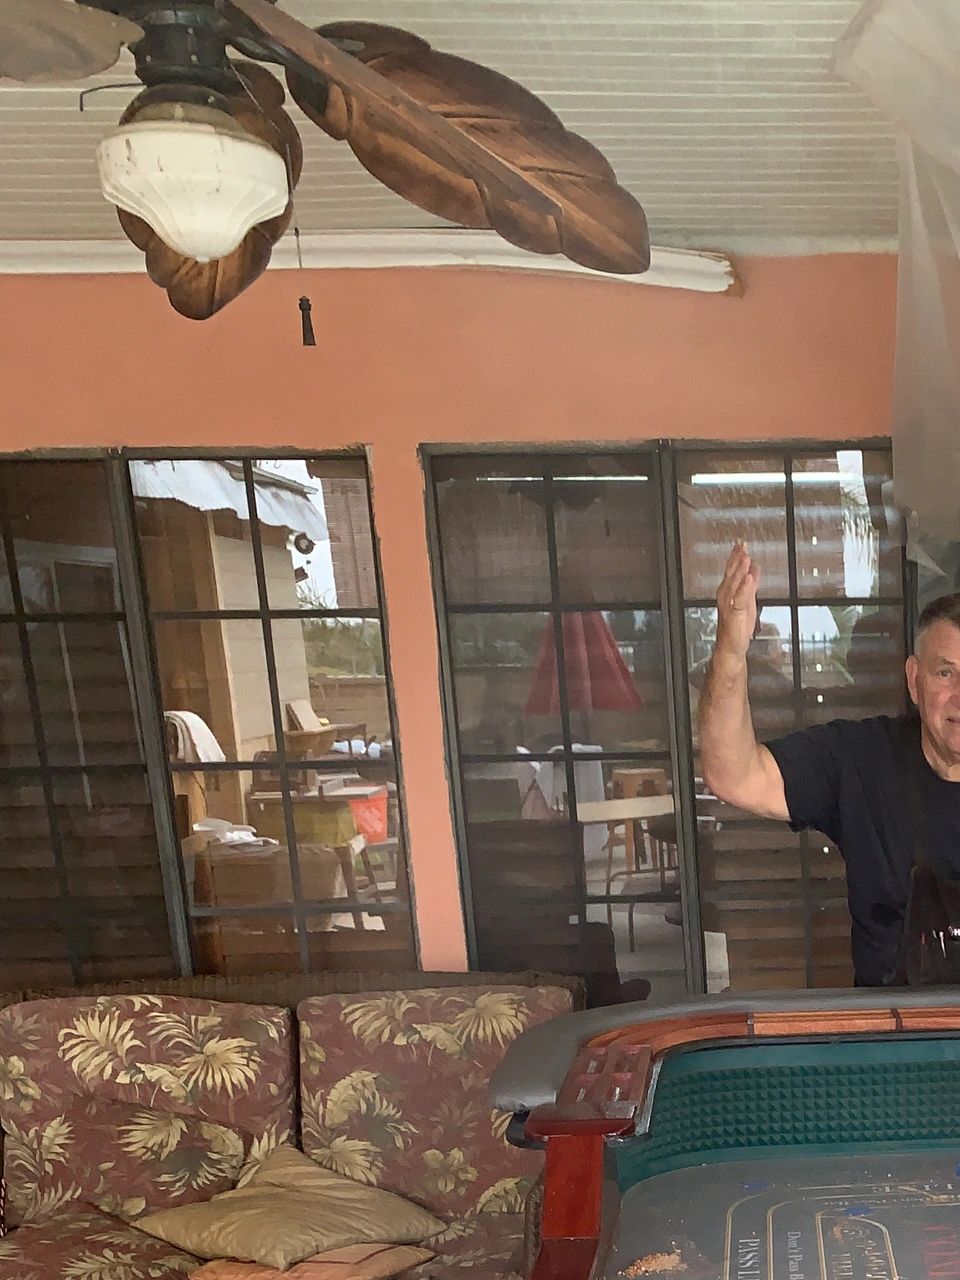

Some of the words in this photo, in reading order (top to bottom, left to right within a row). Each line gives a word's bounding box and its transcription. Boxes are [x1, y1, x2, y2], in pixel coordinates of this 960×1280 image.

[787, 1231, 801, 1252] Don't
[738, 1238, 761, 1269] PASS
[788, 1254, 803, 1272] Pass
